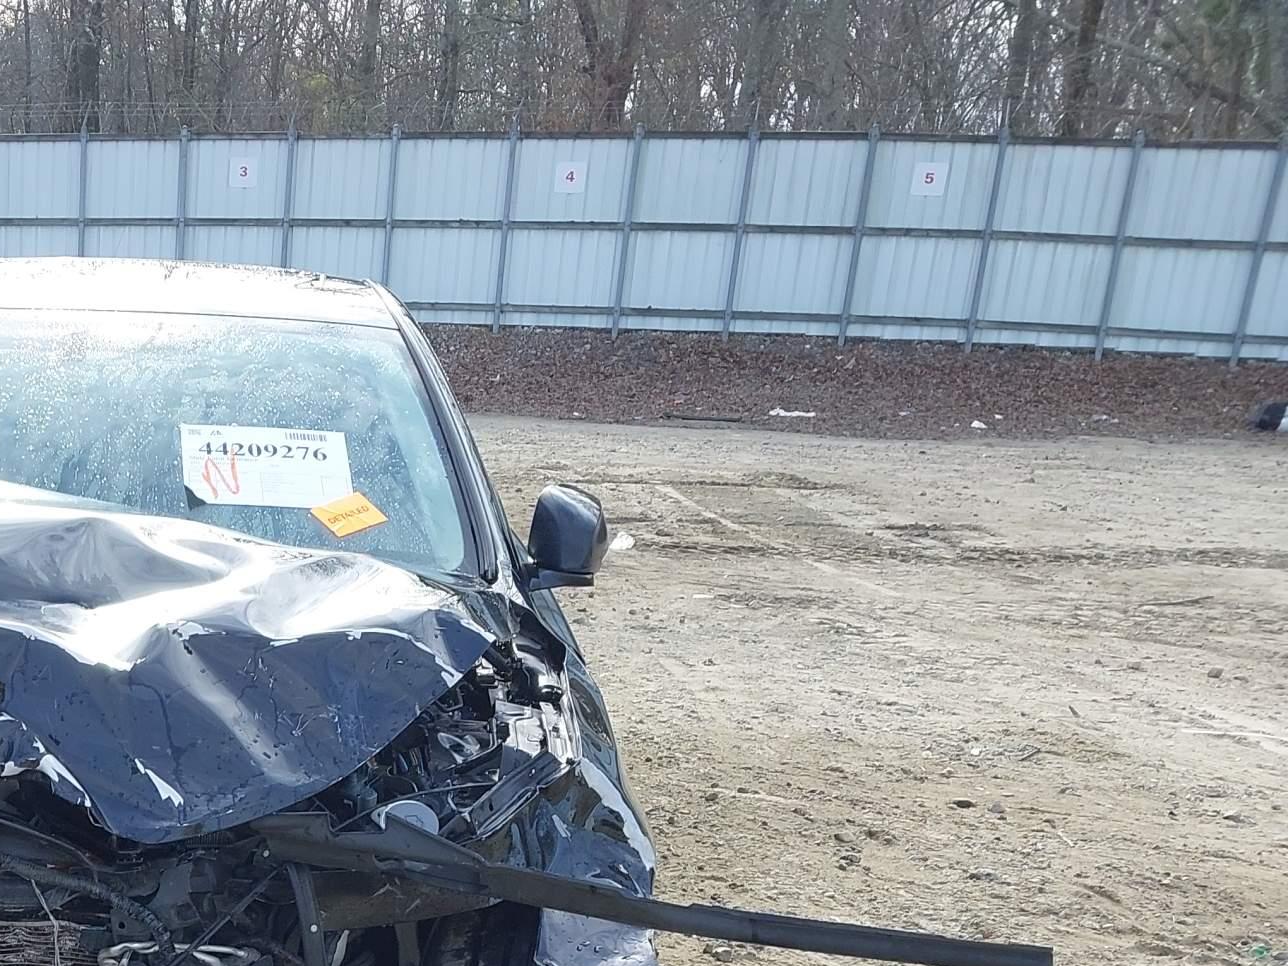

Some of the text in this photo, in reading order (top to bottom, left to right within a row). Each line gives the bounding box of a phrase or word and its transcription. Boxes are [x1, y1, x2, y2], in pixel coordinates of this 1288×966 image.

[239, 166, 248, 177] 3
[565, 170, 576, 183] 4
[924, 172, 935, 185] 5
[198, 441, 328, 461] 44209276
[327, 505, 370, 525] DETAILED
